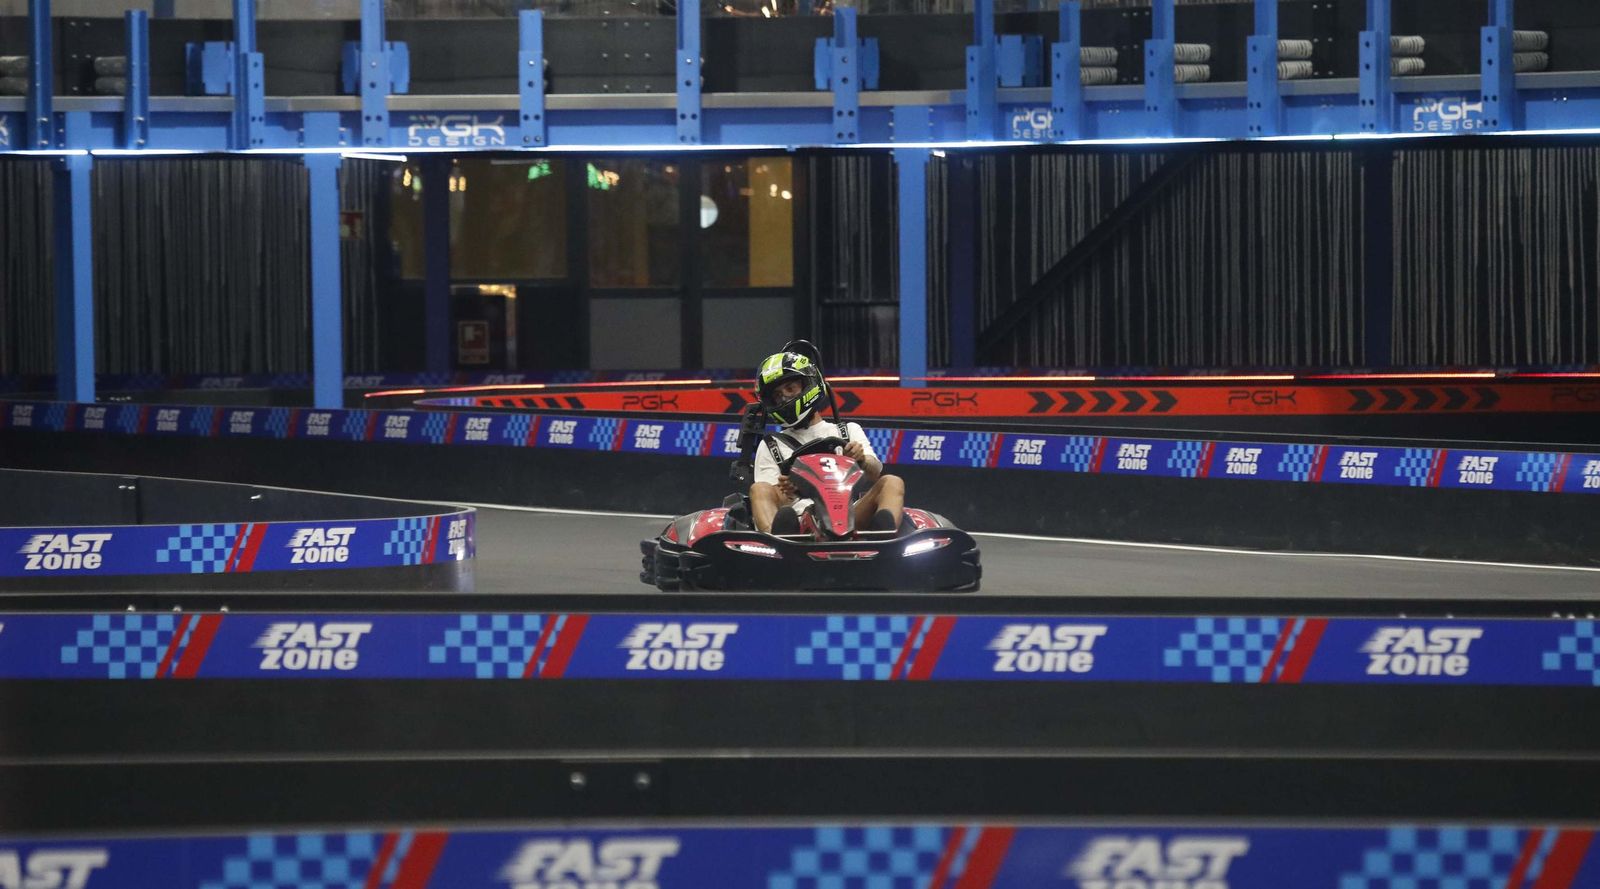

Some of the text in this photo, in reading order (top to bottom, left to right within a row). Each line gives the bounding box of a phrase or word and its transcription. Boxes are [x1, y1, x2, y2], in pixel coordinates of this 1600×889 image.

[408, 115, 505, 137] PGK
[1012, 108, 1054, 129] PG
[408, 136, 505, 146] DESIGN
[622, 394, 679, 410] PGK
[911, 391, 978, 407] PGK
[1228, 390, 1297, 406] PGK
[1551, 387, 1600, 403] PG
[385, 415, 411, 427] FAST
[465, 418, 492, 430] FAST
[549, 420, 577, 433] FAST
[635, 424, 664, 438] FAST
[635, 437, 660, 449] zone
[913, 435, 946, 450] FAST
[1013, 438, 1046, 453] FAST
[1117, 443, 1152, 458] FAST
[913, 449, 942, 461] zone
[1013, 453, 1042, 465] zone
[1226, 447, 1262, 462] FAST
[1339, 451, 1378, 466] FAST
[820, 457, 837, 473] 3
[1117, 457, 1148, 470] zone
[1226, 462, 1258, 475] zone
[1459, 456, 1498, 471] FAST
[1340, 466, 1374, 479] zone
[1459, 470, 1493, 484] zone
[1583, 474, 1600, 488] zo
[17, 533, 113, 554] FAST
[287, 527, 356, 548] FAST
[24, 553, 102, 570] zone
[290, 546, 350, 564] zone
[253, 623, 372, 649] FAST
[617, 623, 739, 650] FAST
[987, 625, 1108, 651] FAST
[1359, 627, 1484, 653] FAST
[259, 648, 359, 670] zone
[625, 649, 725, 671] zone
[993, 650, 1094, 673] zone
[1366, 653, 1470, 676] zone
[500, 837, 682, 882] FAST
[1068, 837, 1250, 882] FAST
